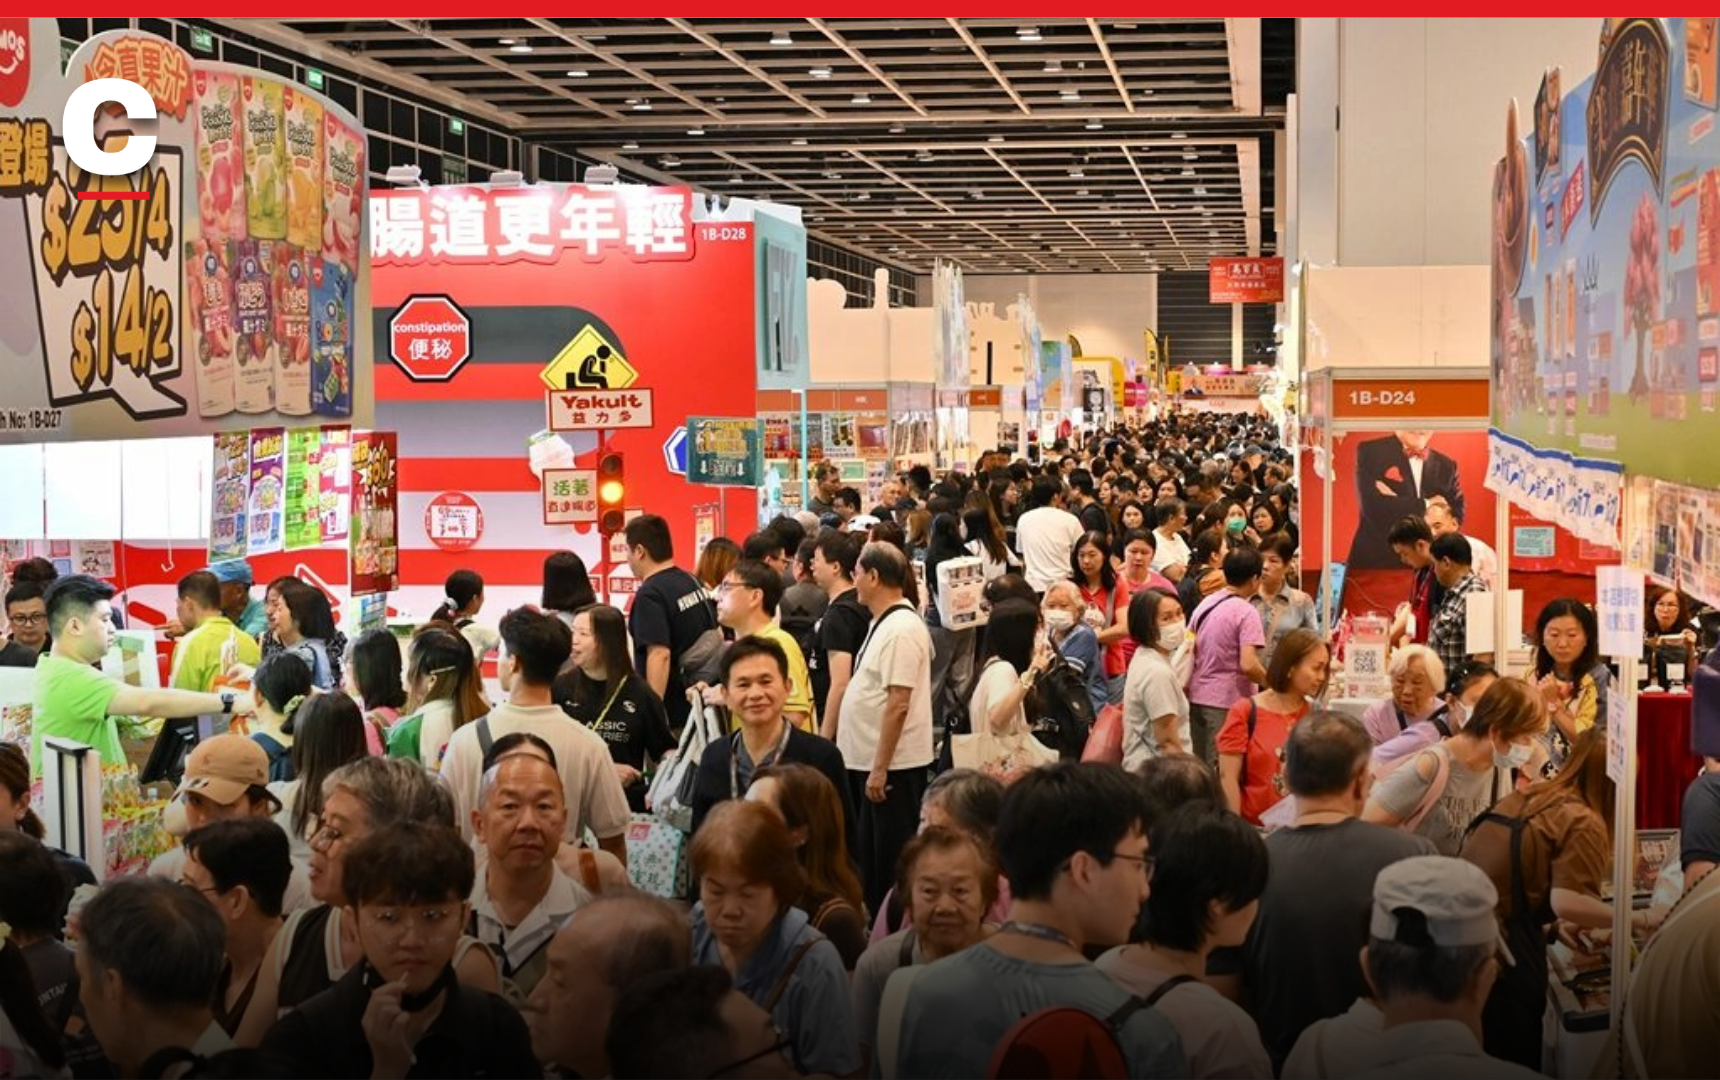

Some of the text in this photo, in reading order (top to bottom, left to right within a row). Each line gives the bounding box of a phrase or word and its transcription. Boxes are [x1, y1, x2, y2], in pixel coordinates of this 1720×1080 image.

[370, 192, 687, 257] 腸道更年輕
[701, 227, 747, 241] 1B-D28
[72, 262, 170, 388] $14/2
[393, 321, 466, 334] constipation
[408, 338, 453, 361] 便秘
[560, 394, 643, 410] Yakult
[1349, 390, 1416, 405] 1B-D24
[9, 411, 27, 429] No:
[28, 411, 62, 428] 1B-D27
[571, 411, 632, 424] 益力多
[586, 721, 627, 731] ASSIC
